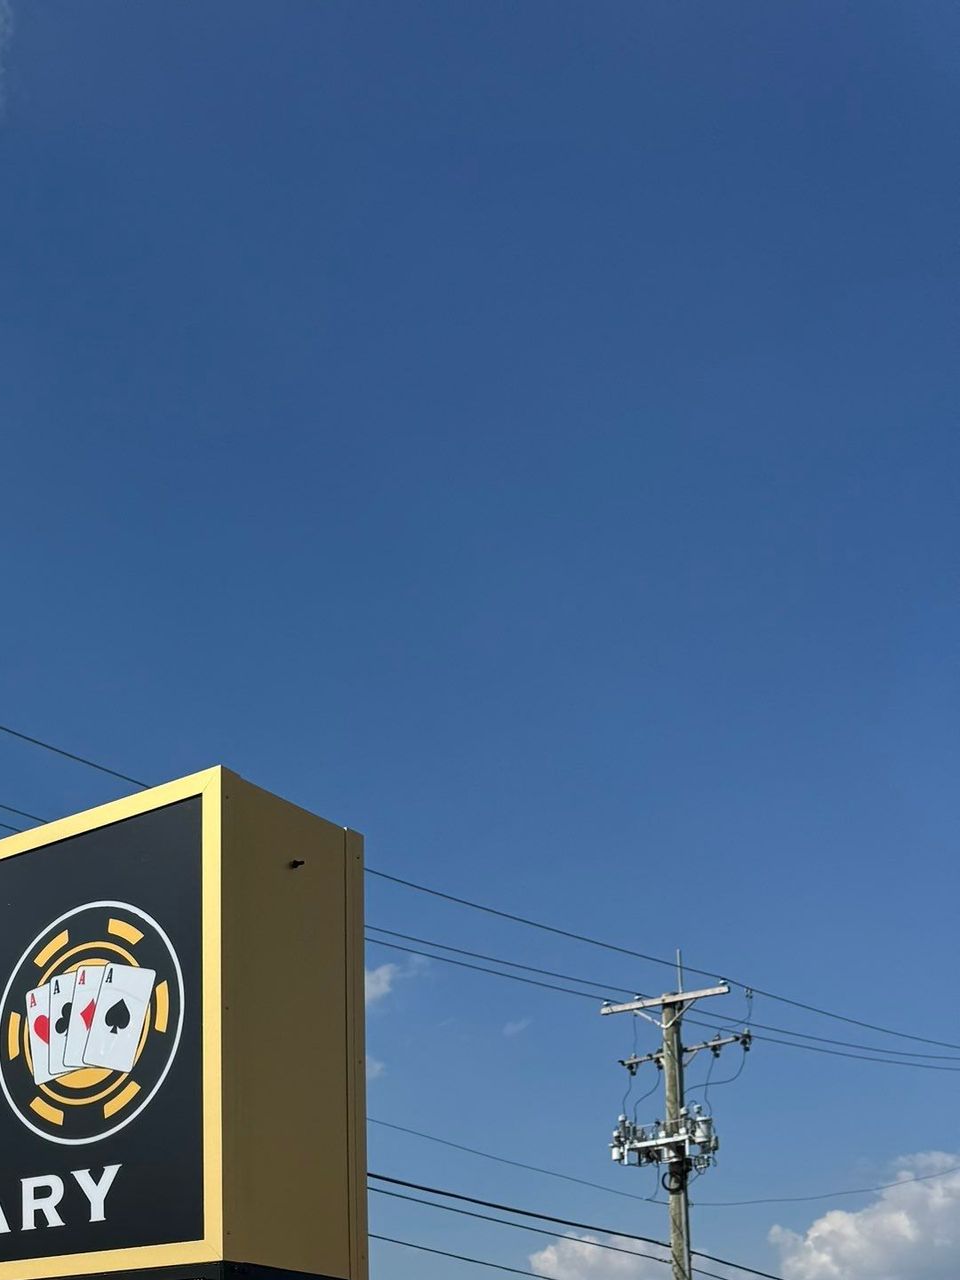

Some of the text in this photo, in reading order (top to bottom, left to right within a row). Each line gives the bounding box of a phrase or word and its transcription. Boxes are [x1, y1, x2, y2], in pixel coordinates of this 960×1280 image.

[78, 970, 86, 985] A
[105, 968, 114, 983] A
[53, 980, 61, 995] A
[30, 993, 37, 1008] A
